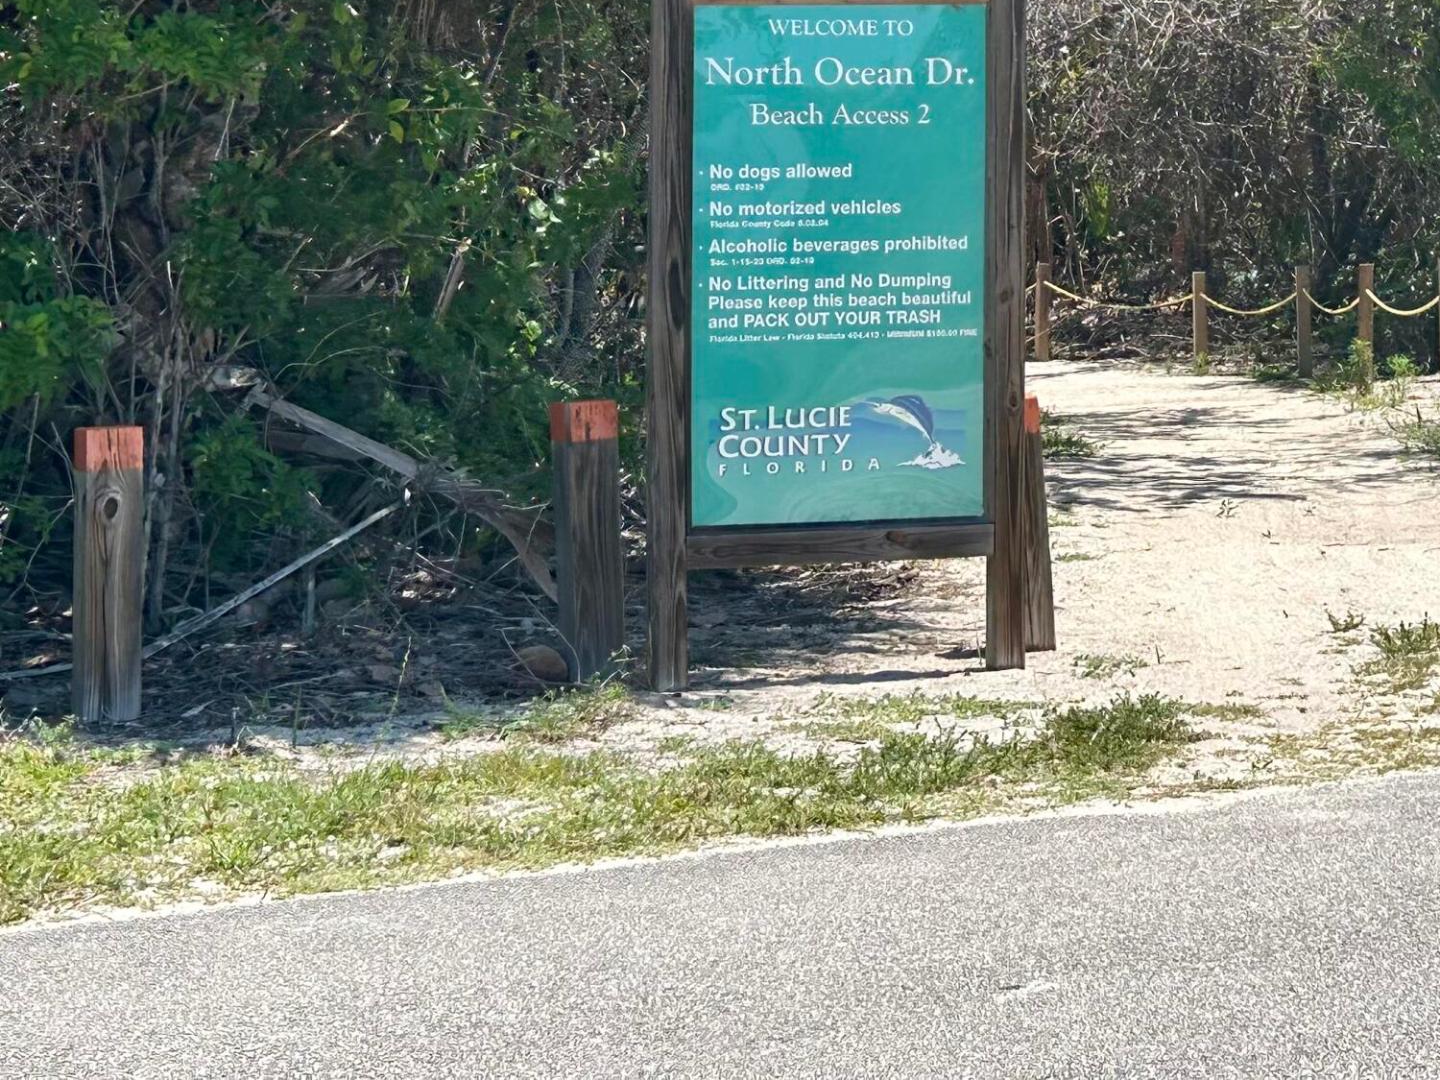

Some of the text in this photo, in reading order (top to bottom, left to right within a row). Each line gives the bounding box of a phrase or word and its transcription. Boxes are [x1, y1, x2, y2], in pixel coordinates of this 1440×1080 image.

[769, 18, 914, 37] WELCOME TO
[704, 56, 975, 86] North Ocean Dr.
[750, 102, 931, 126] Beach Access 2
[709, 162, 853, 183] No dogs allowed
[709, 199, 902, 216] No motorized vehicles
[710, 220, 739, 228] Florida
[741, 220, 771, 229] County
[708, 235, 969, 255] Alcoholic beverages prohibited
[709, 272, 952, 293] No Littering and No Dumping
[708, 290, 972, 312] Please keep this beach beautiful
[708, 309, 942, 329] and PACK OUT YOUR TRASH
[720, 405, 853, 432] ST. LUCIE
[718, 433, 852, 459] COUNTY
[718, 458, 881, 477] FLORIDA
